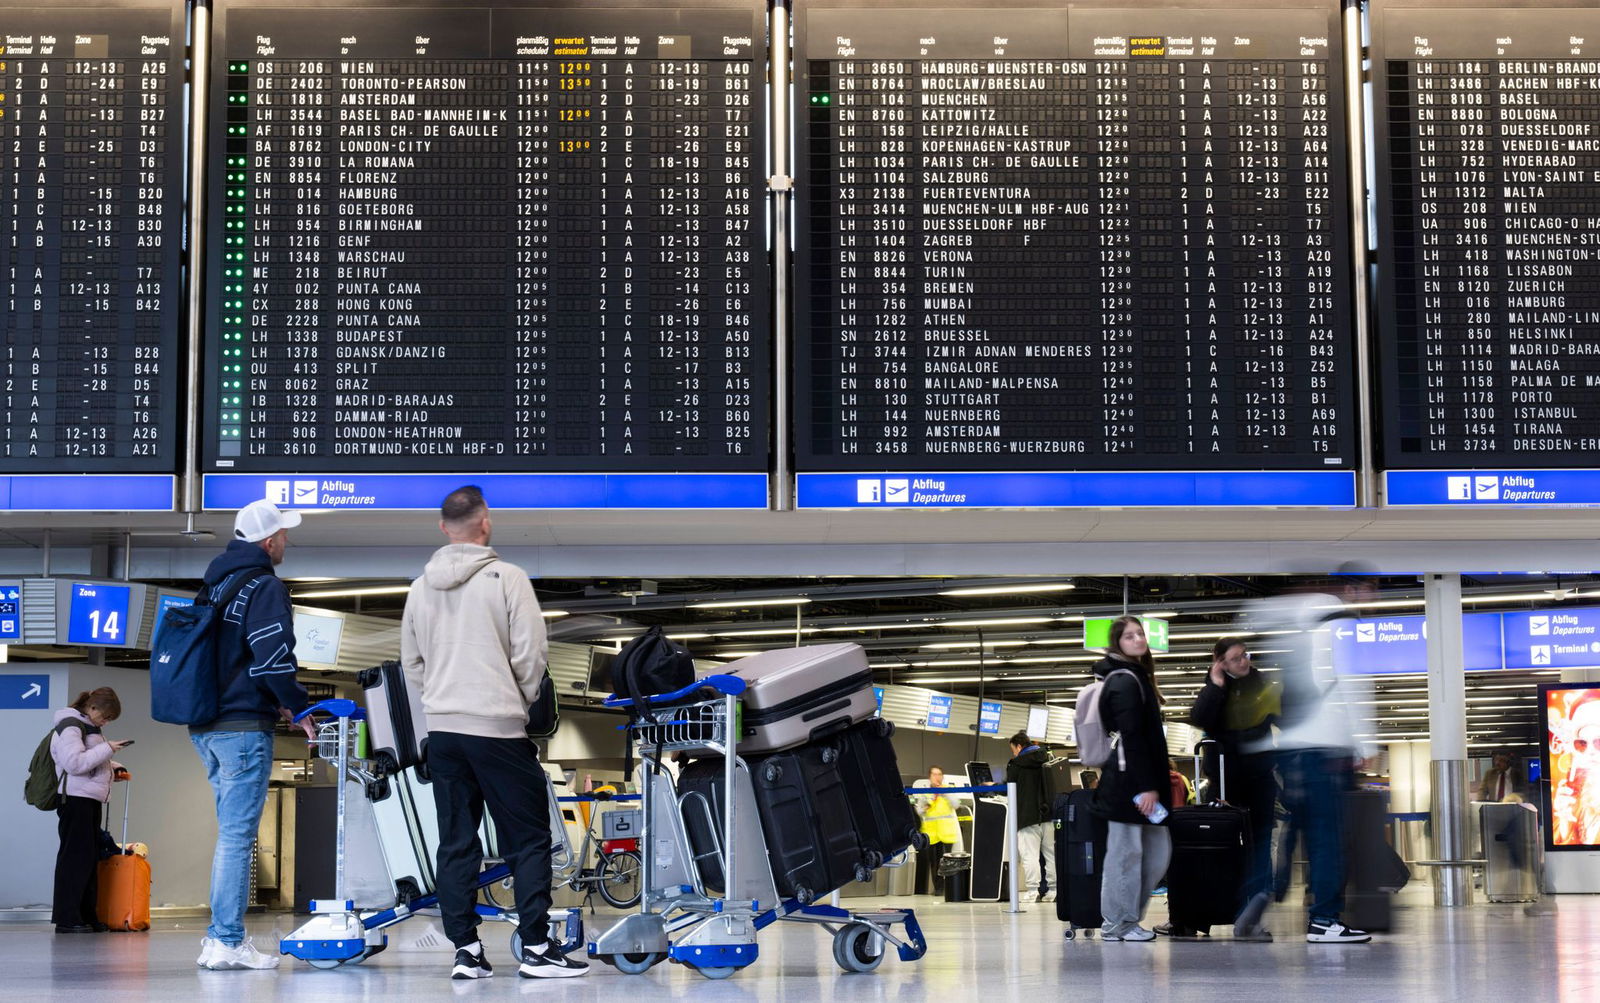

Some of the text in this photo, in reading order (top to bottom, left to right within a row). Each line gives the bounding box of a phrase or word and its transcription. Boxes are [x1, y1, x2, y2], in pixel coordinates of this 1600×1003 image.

[256, 36, 271, 45] Flug
[340, 36, 357, 45] nach
[415, 35, 430, 45] über
[516, 36, 549, 46] planmäßig
[554, 37, 585, 45] erwartet
[590, 36, 617, 45] Terminal
[624, 36, 641, 45] Halle
[658, 36, 675, 45] Zone
[722, 36, 752, 46] Flugsteig
[256, 46, 276, 55] Flight
[341, 47, 349, 55] to
[416, 47, 426, 55] via
[516, 46, 549, 55] scheduled
[554, 46, 588, 55] estimated
[591, 46, 618, 55] Terminal
[624, 46, 638, 55] Hall
[723, 46, 739, 55] Gate
[141, 62, 166, 74] A25
[257, 61, 374, 74] OS 206 WIEN
[921, 61, 1087, 75] HAMBURG-MUENSTER-OSN
[141, 77, 158, 90] E9
[340, 77, 466, 90] TORONTO-PEARSON
[921, 77, 1046, 90] WROCLAW/BRESLAU
[1498, 77, 1600, 90] AACHEN HBF-K
[340, 93, 415, 106] AMSTERDAM
[921, 92, 1326, 106] MUENCHEN A56
[1499, 93, 1540, 105] BASEL
[140, 109, 165, 121] B27
[256, 109, 507, 121] LH 3544 BASEL BAD-MANNHEIM-K
[921, 109, 996, 121] KATTOWITZ
[1500, 108, 1558, 121] BOLOGNA
[340, 124, 498, 137] PARIS CH. DE GAULLE
[922, 124, 1029, 137] LEIPZIG/HALLE
[1501, 124, 1591, 136] DUESSELDORF
[140, 140, 156, 153] D3
[340, 140, 431, 153] LONDON-CITY
[922, 140, 1328, 152] KOPENHAGEN-KASTRUP A64
[339, 156, 415, 168] LA ROMANA
[922, 156, 1079, 168] PARIS CH. DE GAULLE
[1502, 155, 1576, 167] HYDERABAD
[340, 172, 397, 184] FLORENZ
[923, 171, 989, 184] SALZBURG
[1503, 170, 1585, 183] LYON-SAINT
[139, 187, 163, 199] B20
[339, 187, 397, 200] HAMBURG
[923, 187, 1031, 199] FUERTEVENTURA
[1503, 186, 1545, 198] MALTA
[138, 203, 162, 216] B48
[338, 203, 414, 216] GOETEBORG
[923, 203, 1089, 215] MUENCHEN-ULM HBF-AUG
[1504, 202, 1537, 214] WIEN
[339, 219, 422, 231] BIRMINGHAM
[923, 218, 1047, 231] DUESSELDORF HBF
[1505, 217, 1579, 229] CHICAGO-O
[137, 235, 162, 247] A30
[338, 235, 371, 247] GENF
[923, 234, 1030, 247] ZAGREB F
[338, 251, 405, 263] WARSCHAU
[923, 250, 973, 262] VERONA
[337, 267, 387, 279] BEIRUT
[924, 266, 965, 278] TURIN
[1507, 264, 1572, 277] LISSABON
[136, 283, 161, 295] A13
[253, 282, 421, 295] 4Y 002 PUNTA CANA
[924, 282, 974, 294] BREMEN
[1507, 280, 1565, 292] ZUERICH
[337, 298, 412, 311] HONG KONG
[924, 297, 1332, 310] MUMBAI Z15
[1508, 296, 1565, 308] HAMBURG
[337, 314, 421, 326] PUNTA CANA
[924, 314, 965, 325] ATHEN
[1508, 312, 1599, 324] MAILAND-LIN
[336, 330, 403, 342] BUDAPEST
[924, 329, 990, 342] BRUESSEL
[1509, 328, 1573, 339] HELSINKI
[135, 347, 159, 359] B28
[336, 346, 445, 358] GDANSK/DANZIG
[927, 345, 1334, 357] IZMIR ADNAN MENDERES B43
[336, 362, 377, 374] SPLIT
[925, 360, 1334, 373] BANGALORE Z52
[1510, 359, 1560, 371] MALAGA
[134, 379, 150, 391] D5
[336, 378, 369, 390] GRAZ
[925, 377, 1059, 389] MAILAND-MALPENSA
[1511, 375, 1552, 387] PALMA
[1561, 375, 1576, 387] DE
[335, 394, 454, 406] MADRID-BARAJAS
[925, 393, 1000, 405] STUTTGART
[1512, 391, 1552, 403] PORTO
[335, 410, 428, 422] DAMMAM-RIAD
[925, 409, 1000, 421] NUERNBERG
[1514, 407, 1577, 419] ISTANBUL
[133, 427, 157, 439] A26
[335, 426, 462, 439] LONDON-HEATHROW
[925, 425, 1000, 437] AMSTERDAM
[1513, 423, 1563, 434] TIRANA
[334, 442, 504, 455] DORTMUND-KOELN HBF-D
[925, 440, 1328, 453] NUERNBERG-WUERZBURG T5
[1513, 438, 1600, 451] DRESDEN-ER
[321, 480, 355, 493] Abflug
[912, 478, 946, 491] Abflug
[1502, 475, 1535, 488] Abflug
[321, 493, 376, 507] Departures
[912, 492, 966, 504] Departures
[1502, 489, 1556, 501] Departures
[79, 587, 97, 597] Zone
[88, 610, 120, 640] 14
[1552, 614, 1579, 625] Abflug
[1377, 622, 1403, 632] Abflug
[1552, 625, 1595, 636] Departures
[1378, 632, 1419, 643] Departures
[1552, 643, 1588, 654] Terminal
